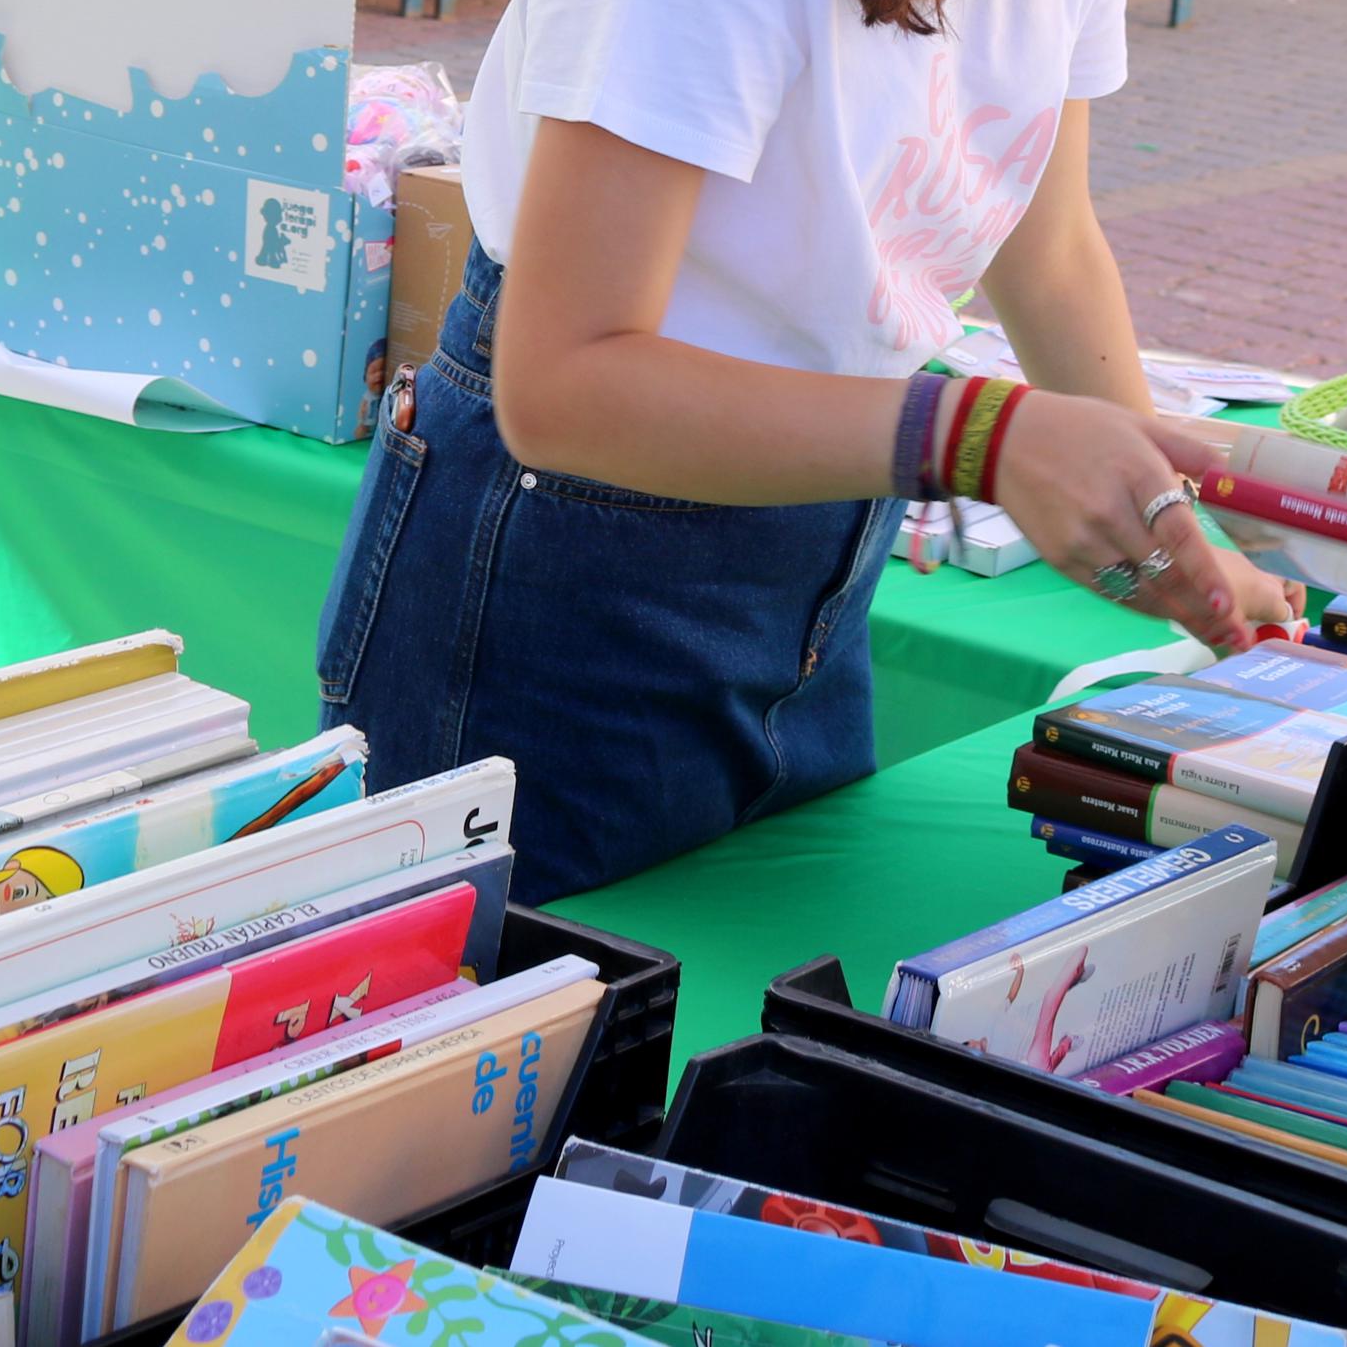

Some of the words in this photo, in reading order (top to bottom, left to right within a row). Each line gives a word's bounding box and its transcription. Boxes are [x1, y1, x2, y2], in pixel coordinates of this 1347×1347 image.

[1279, 494, 1324, 520] Mendoza
[1091, 741, 1119, 759] Matute
[1119, 750, 1142, 765] María
[1143, 758, 1161, 770] Ana
[1204, 776, 1227, 790] torre
[1228, 781, 1240, 795] La
[1080, 795, 1117, 812] Montero
[1117, 804, 1139, 818] Isaac
[1159, 816, 1202, 834] tormenta
[1080, 835, 1129, 856] Monterroso
[1061, 846, 1213, 912] GEMELIERS
[301, 903, 321, 919] EL
[225, 908, 298, 947] CAPITÁN
[147, 931, 224, 969] TRUENO
[286, 1076, 350, 1106] CUENTOS
[353, 1066, 377, 1084] DE
[471, 1051, 508, 1116] de
